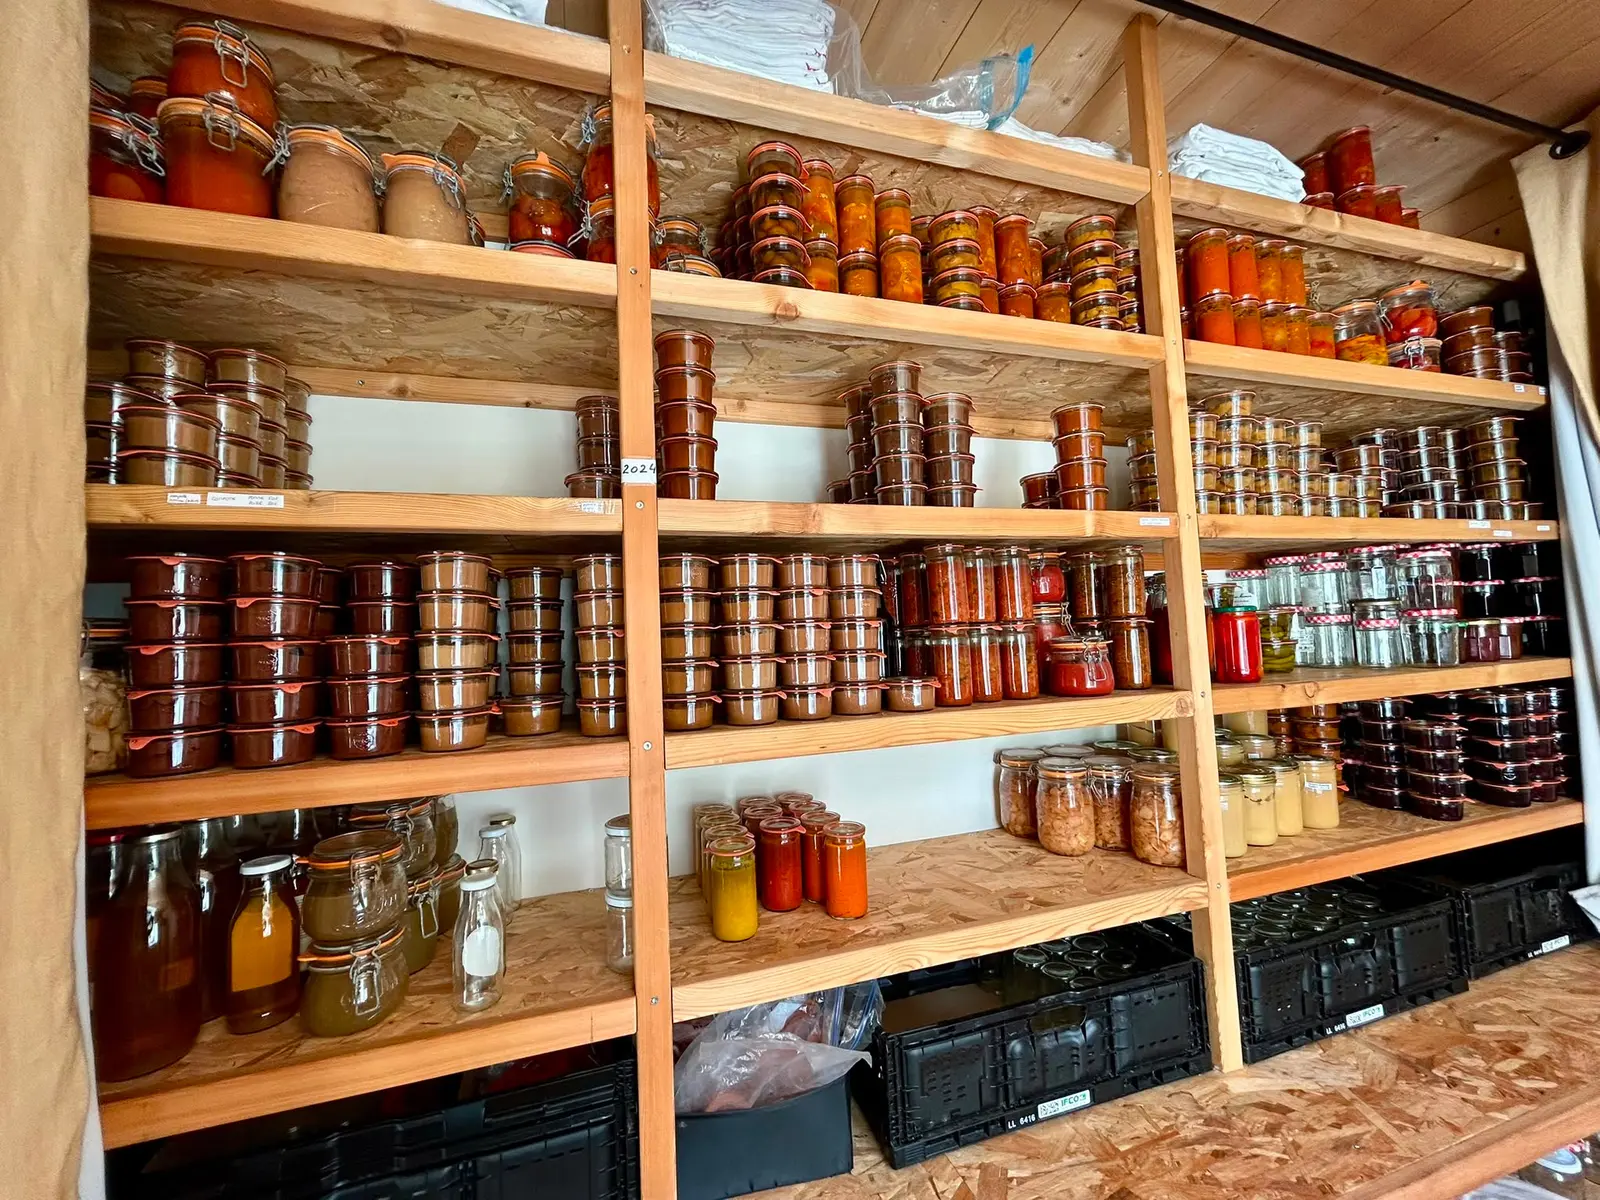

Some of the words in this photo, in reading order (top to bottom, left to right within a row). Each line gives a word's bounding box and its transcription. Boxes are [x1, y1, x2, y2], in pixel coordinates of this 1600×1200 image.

[623, 464, 656, 474] 2024
[1061, 1096, 1079, 1106] IFCO
[1008, 1121, 1016, 1129] LL
[1020, 1114, 1035, 1125] 6416
